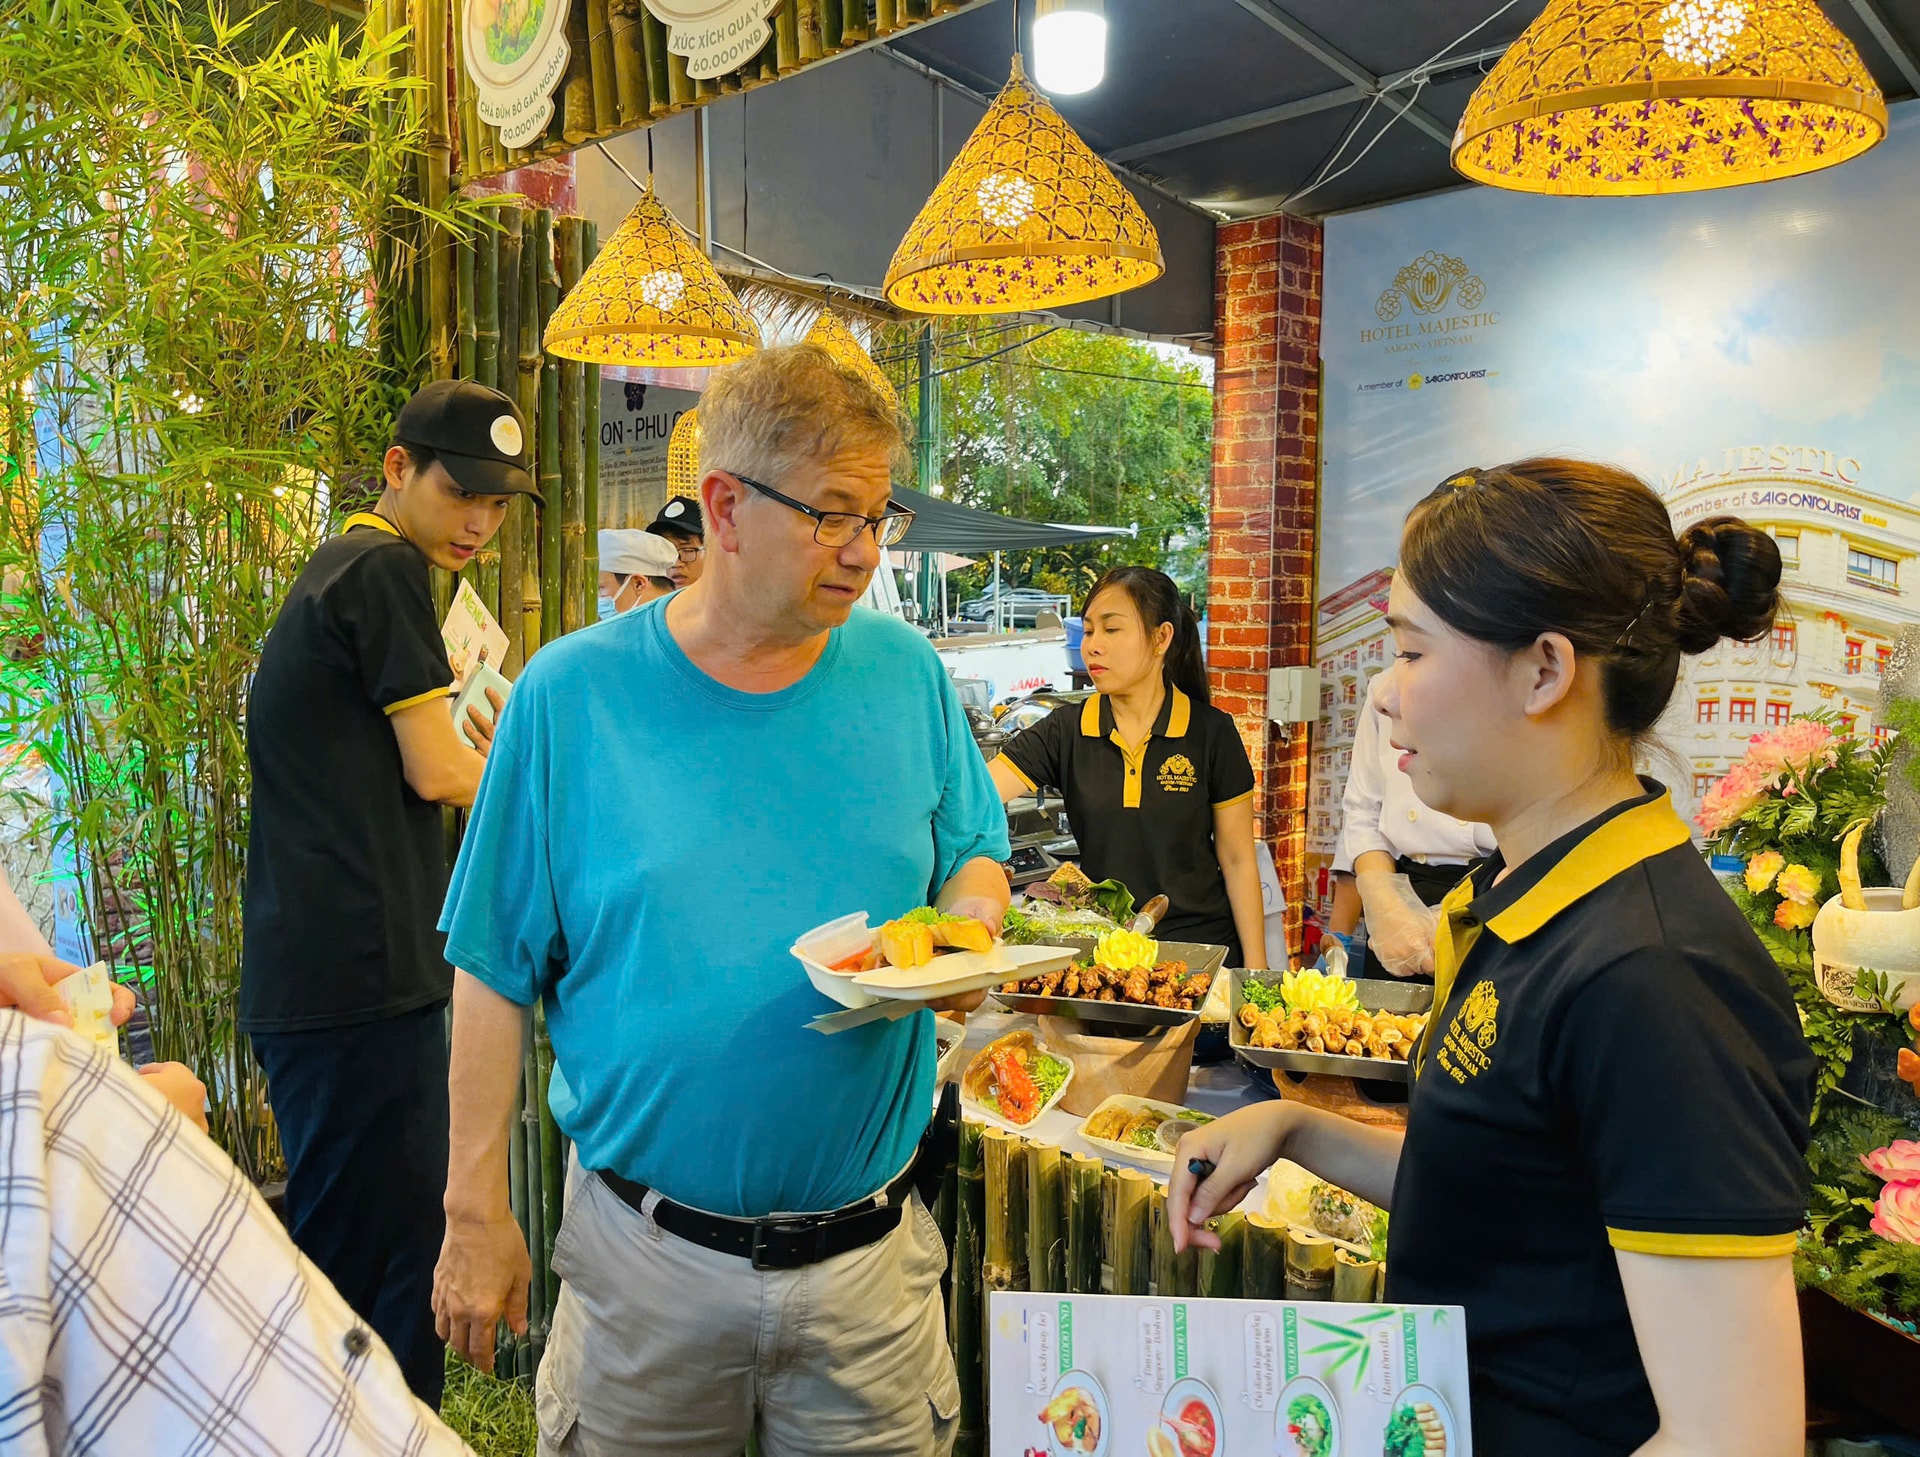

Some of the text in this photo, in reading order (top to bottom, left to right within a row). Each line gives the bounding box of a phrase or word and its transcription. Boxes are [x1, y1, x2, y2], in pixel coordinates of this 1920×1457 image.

[673, 32, 695, 51] XÚC
[698, 29, 725, 50] XÍCH
[727, 2, 759, 37] QUAY
[523, 88, 539, 109] GAN
[1360, 311, 1501, 343] HOTEL MAJESTIC
[1384, 341, 1420, 354] SAIGON
[1427, 335, 1473, 348] VIETNAM
[1356, 382, 1363, 392] A
[1364, 380, 1394, 391] member
[1395, 379, 1403, 388] of
[1425, 369, 1487, 384] SAIGONTOURIST
[1660, 446, 1862, 496] MAJESTIC
[1672, 498, 1727, 522] member
[1732, 491, 1748, 508] of
[1751, 491, 1862, 521] SAIGONTOURIST
[1458, 1031, 1492, 1070] MAJESTIC
